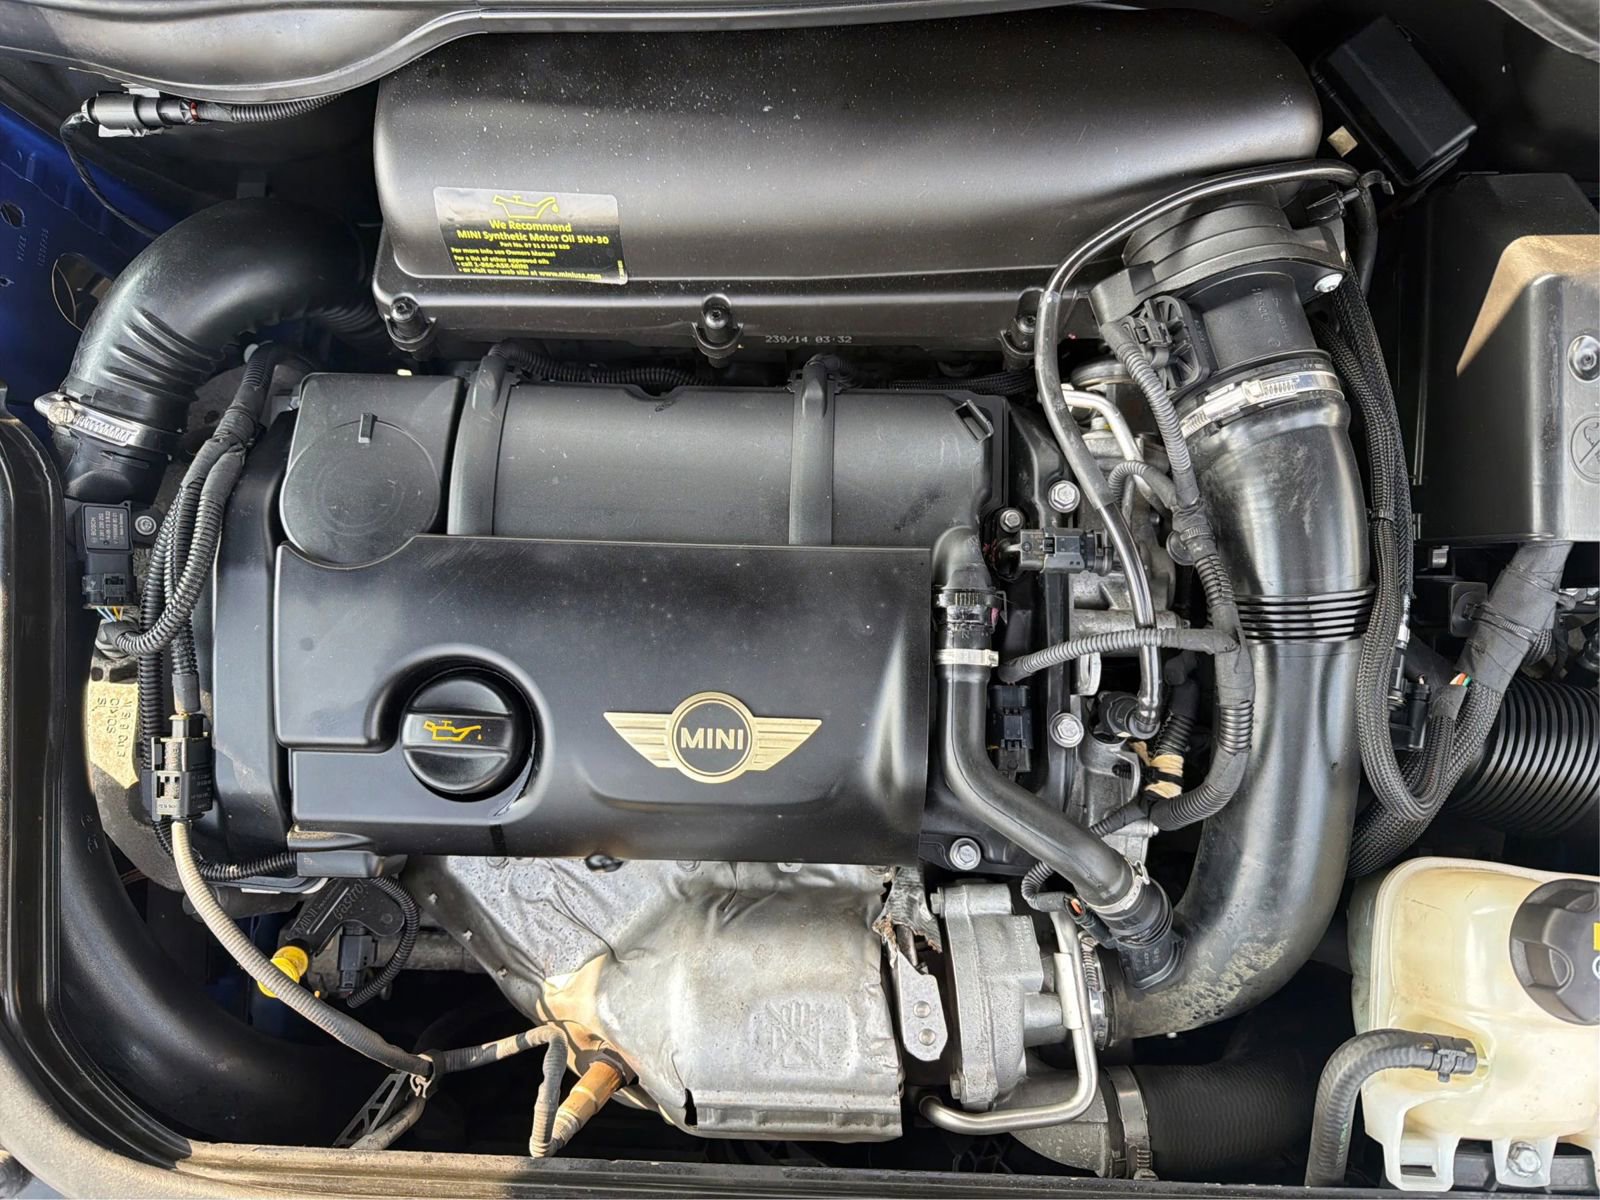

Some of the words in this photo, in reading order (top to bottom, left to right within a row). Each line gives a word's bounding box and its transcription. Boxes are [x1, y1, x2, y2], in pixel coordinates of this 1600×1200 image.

[489, 219, 507, 230] We
[509, 220, 572, 233] Recommend
[457, 230, 482, 240] MINI
[483, 231, 528, 243] Synthetic
[530, 233, 560, 243] Motor
[561, 234, 575, 244] Oil
[577, 235, 609, 245] 5W-30
[507, 257, 537, 265] approved
[538, 271, 602, 280] www.miniusa.com
[765, 335, 808, 344] 239/14
[680, 727, 744, 750] MINI
[332, 878, 365, 921] Castrol
[294, 907, 318, 934] MINI
